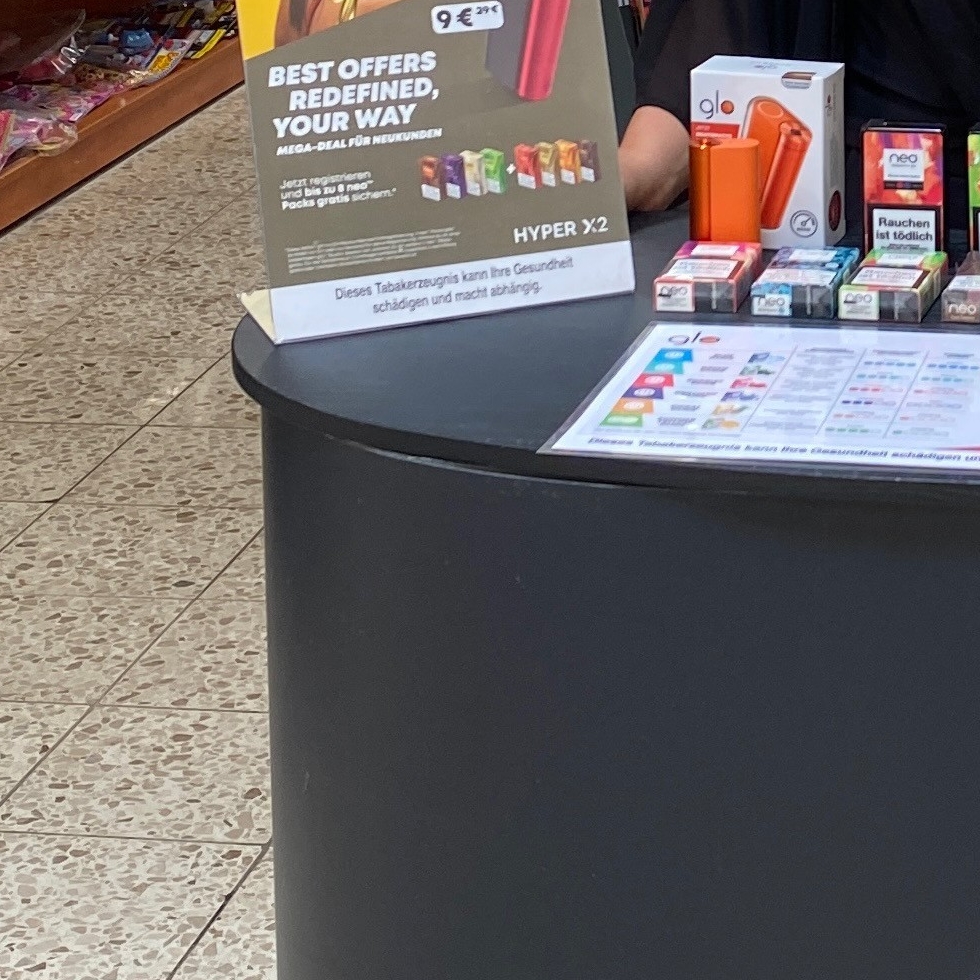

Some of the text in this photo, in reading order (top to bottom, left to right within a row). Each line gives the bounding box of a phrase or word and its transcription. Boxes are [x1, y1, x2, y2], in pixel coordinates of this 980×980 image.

[436, 10, 452, 29] 9
[456, 7, 473, 27] €
[268, 50, 437, 87] BEST OFFERS
[289, 77, 440, 111] REDEFINED,
[699, 89, 735, 119] glo
[272, 103, 418, 139] YOUR WAY
[276, 128, 443, 156] MEGA-DEAL FÜR NEUKUNDEN
[888, 153, 918, 164] neo
[513, 216, 609, 244] HYPER X2
[875, 230, 933, 242] ist tödlich
[878, 217, 931, 228] Rauchen
[335, 256, 574, 301] Dieses Tabakerzeugnis kann Ihre Gesundheit
[372, 297, 430, 315] schädigen
[432, 291, 453, 306] und
[455, 286, 488, 302] macht
[948, 303, 977, 316] neo
